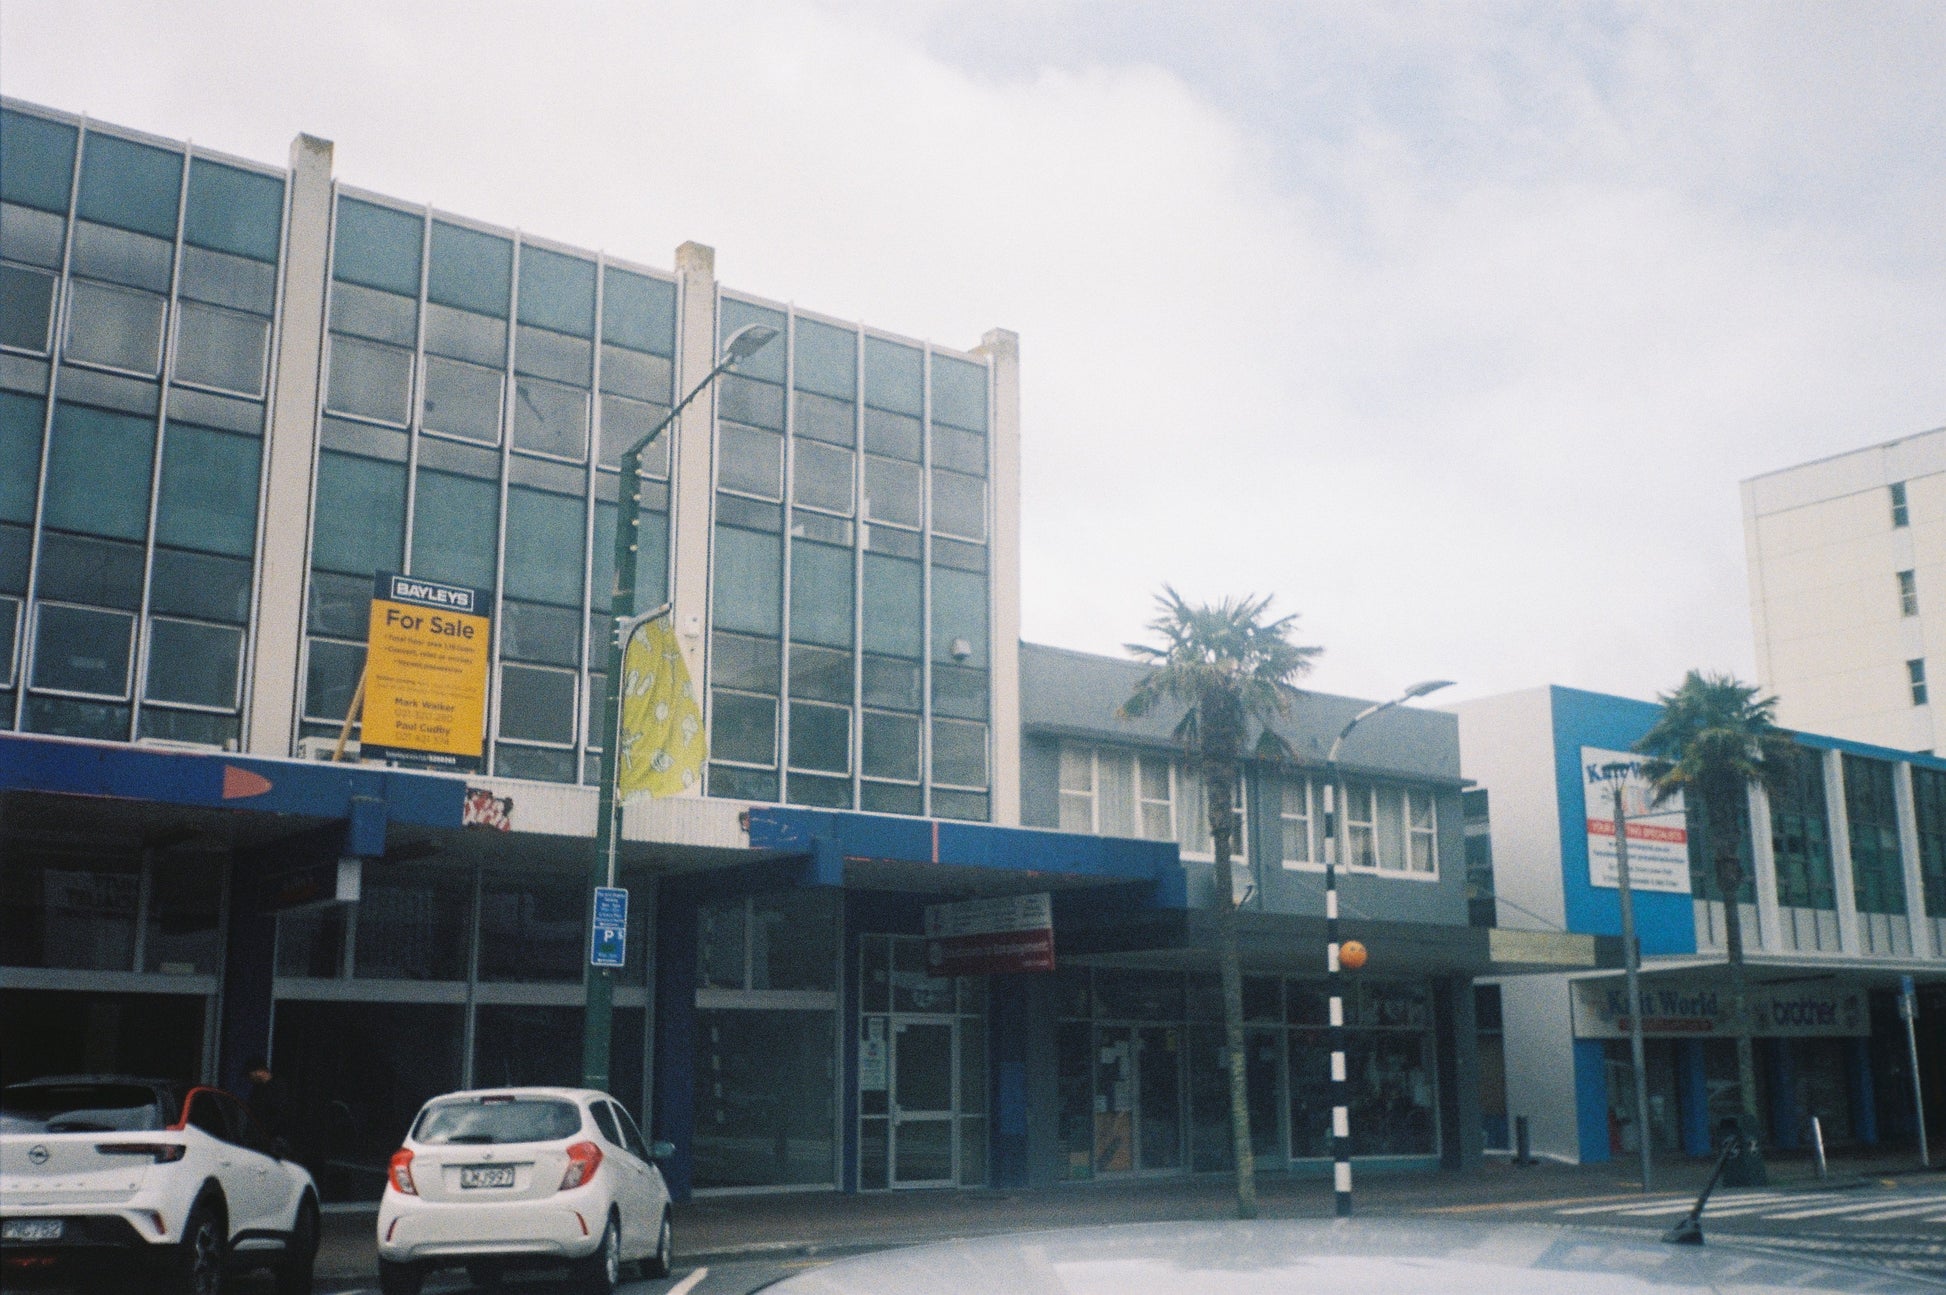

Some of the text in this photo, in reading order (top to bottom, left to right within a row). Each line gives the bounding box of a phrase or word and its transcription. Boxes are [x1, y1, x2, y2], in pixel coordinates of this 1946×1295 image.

[397, 582, 469, 606] BAYLEYS
[386, 608, 475, 640] For Sale
[395, 697, 418, 708] Mark
[396, 720, 417, 731] Paul
[603, 930, 615, 943] P
[1659, 990, 1717, 1015] World
